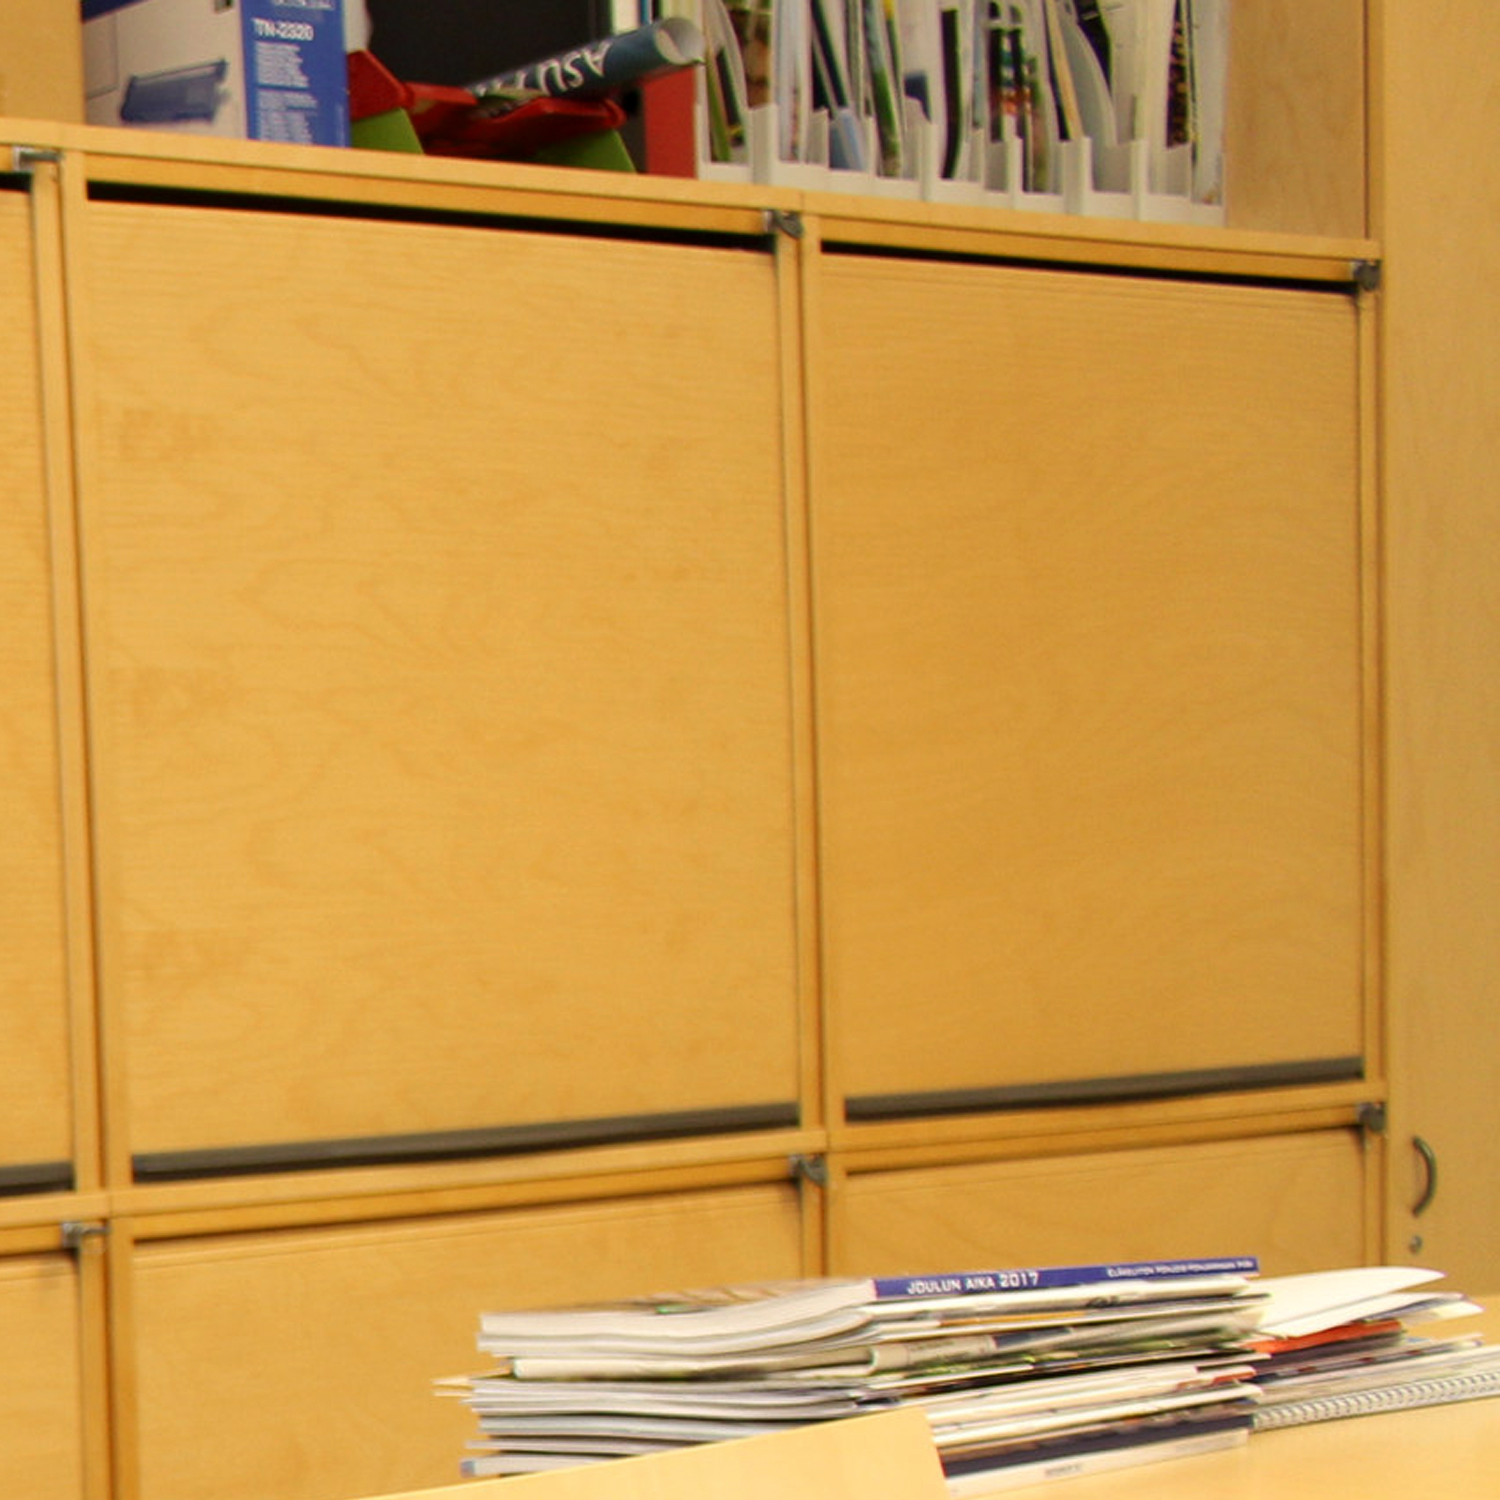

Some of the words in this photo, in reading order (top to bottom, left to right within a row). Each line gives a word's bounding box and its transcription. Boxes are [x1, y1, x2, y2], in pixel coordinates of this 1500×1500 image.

[906, 1278, 962, 1295] JOULUN
[965, 1276, 996, 1290] AIKA
[999, 1271, 1040, 1288] 2017
